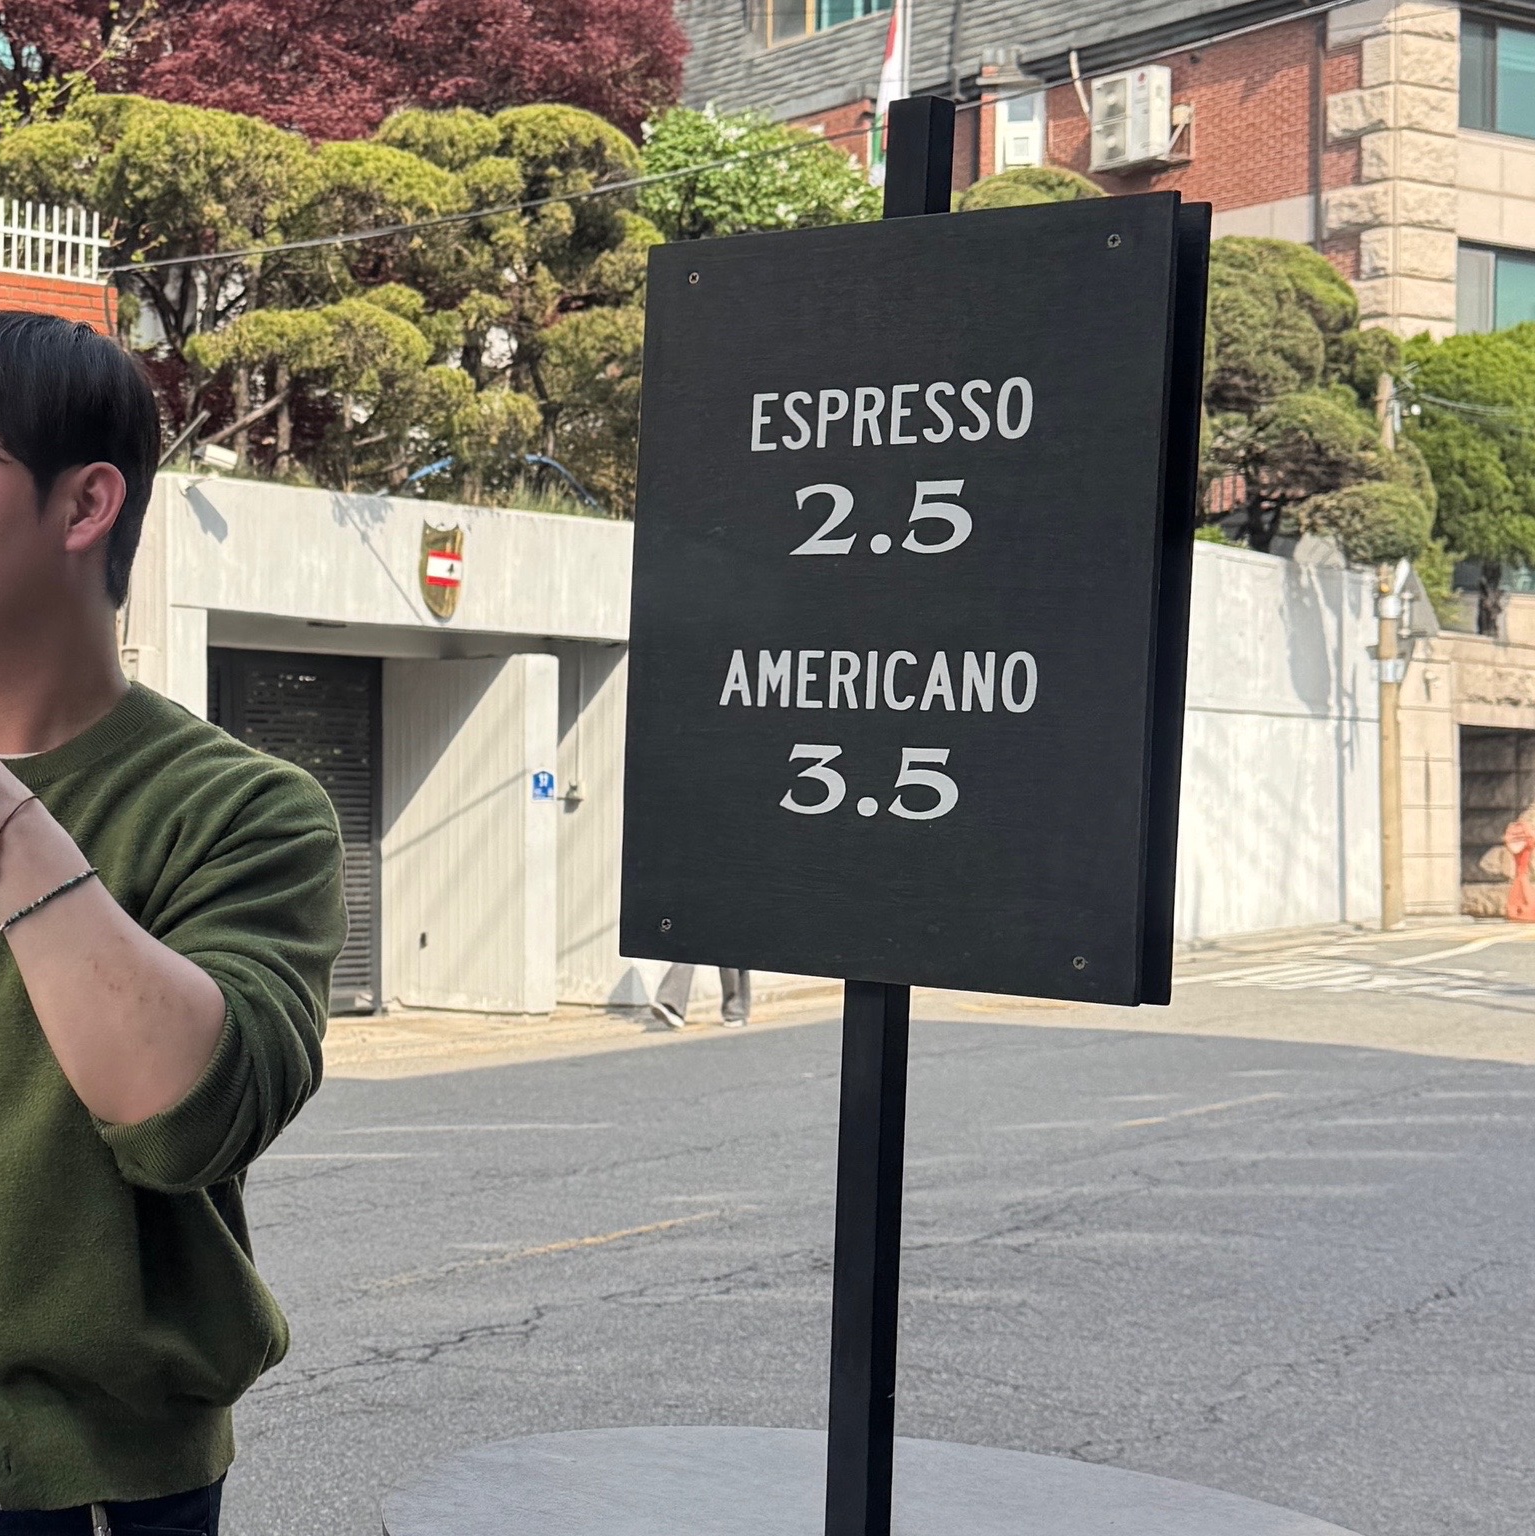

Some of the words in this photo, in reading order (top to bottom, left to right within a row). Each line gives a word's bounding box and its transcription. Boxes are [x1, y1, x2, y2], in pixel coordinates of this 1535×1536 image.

[750, 376, 1034, 452] ESPRESSO
[789, 478, 973, 556] 2.5
[718, 649, 1038, 714] AMERICANO
[779, 743, 959, 821] 3.5
